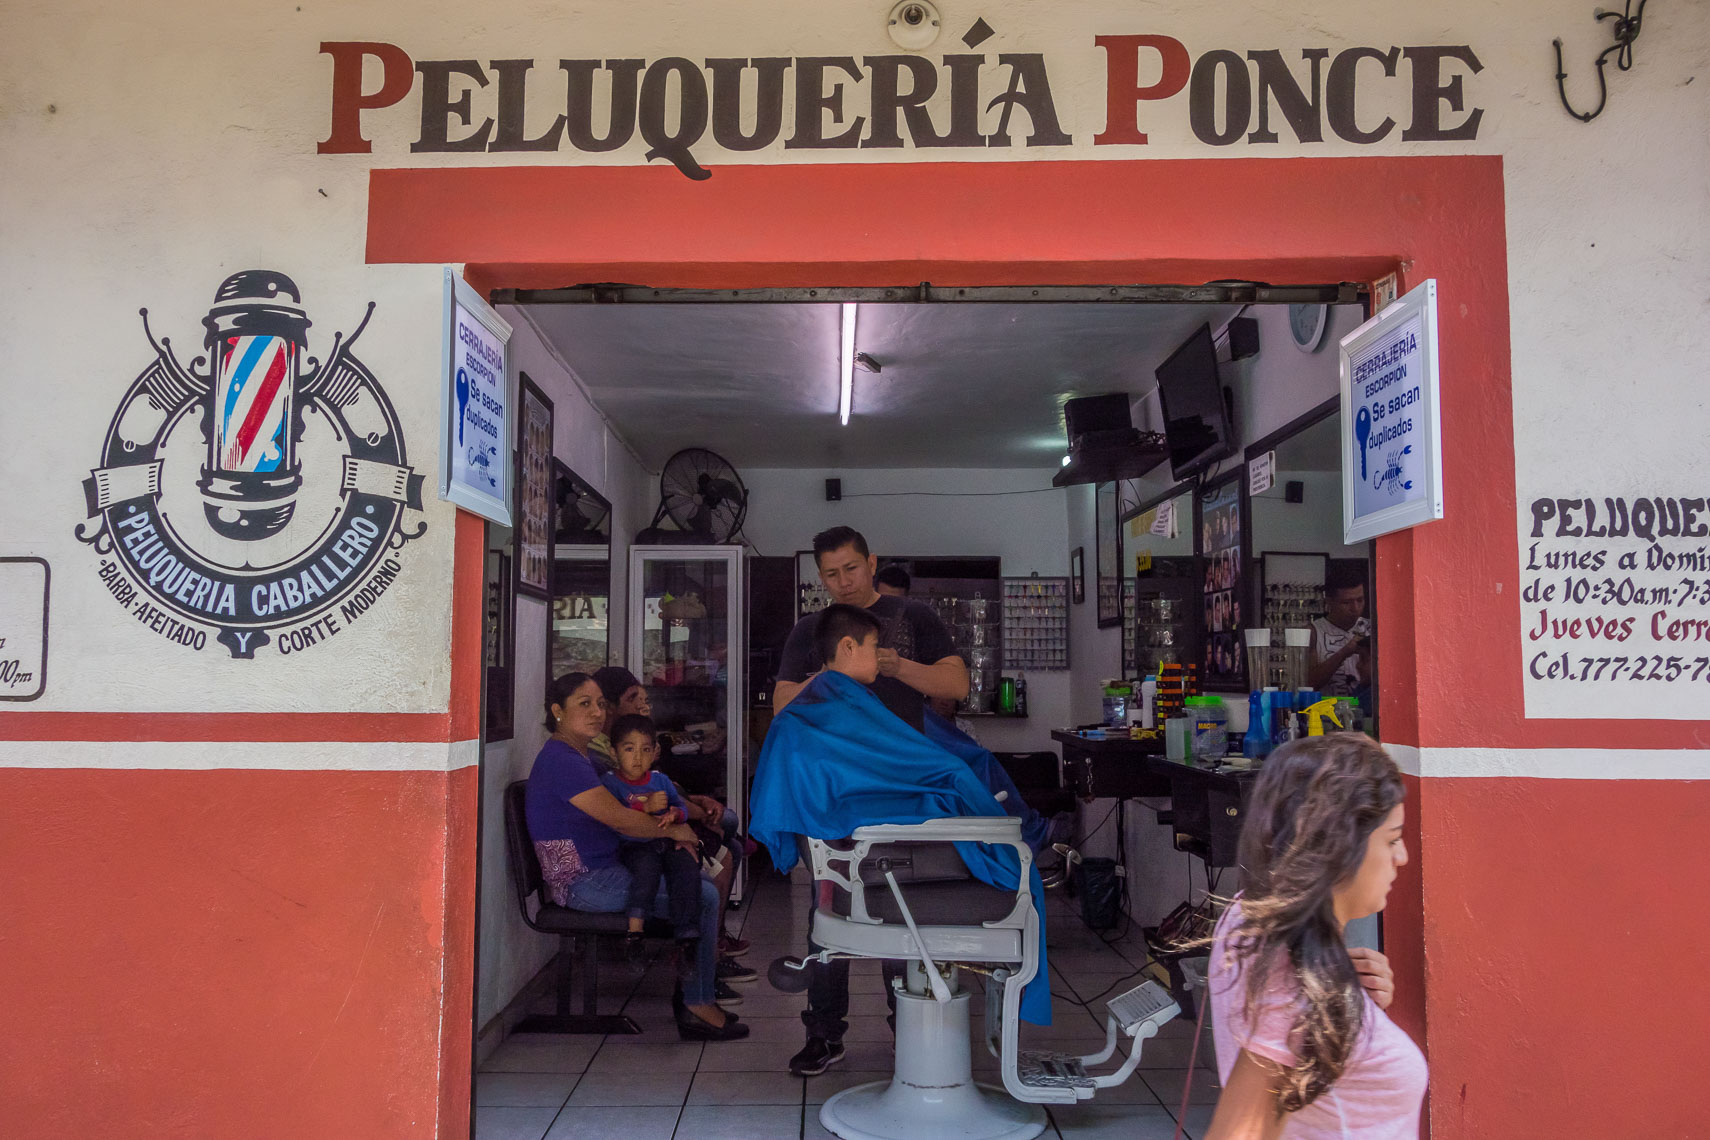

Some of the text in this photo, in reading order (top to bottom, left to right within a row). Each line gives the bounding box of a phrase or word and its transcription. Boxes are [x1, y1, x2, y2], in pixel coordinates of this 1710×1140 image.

[317, 17, 1485, 181] PELUQUERÍA PONCE
[459, 322, 503, 374] CERRAJERÍA
[1355, 331, 1417, 385] CERRAJERÍA
[466, 352, 497, 388] ESCORPIÓN
[1365, 363, 1407, 399] ESCORPIÓN
[470, 378, 504, 420] Se sacan
[1372, 386, 1420, 423] Se sacan
[466, 404, 498, 440] duplicados
[1368, 417, 1413, 450] duplicados
[1530, 497, 1710, 543] PELUQUE
[117, 511, 379, 617] PELUQUERIA CABALLERO
[1526, 541, 1710, 572] Lunes a Domi
[234, 632, 253, 653] Y
[278, 613, 341, 655] CORTE
[340, 558, 402, 625] MODERNO
[1522, 577, 1556, 603] de
[1529, 608, 1710, 643] Jueves Cerr
[1529, 650, 1710, 684] Cel.777-225-7
